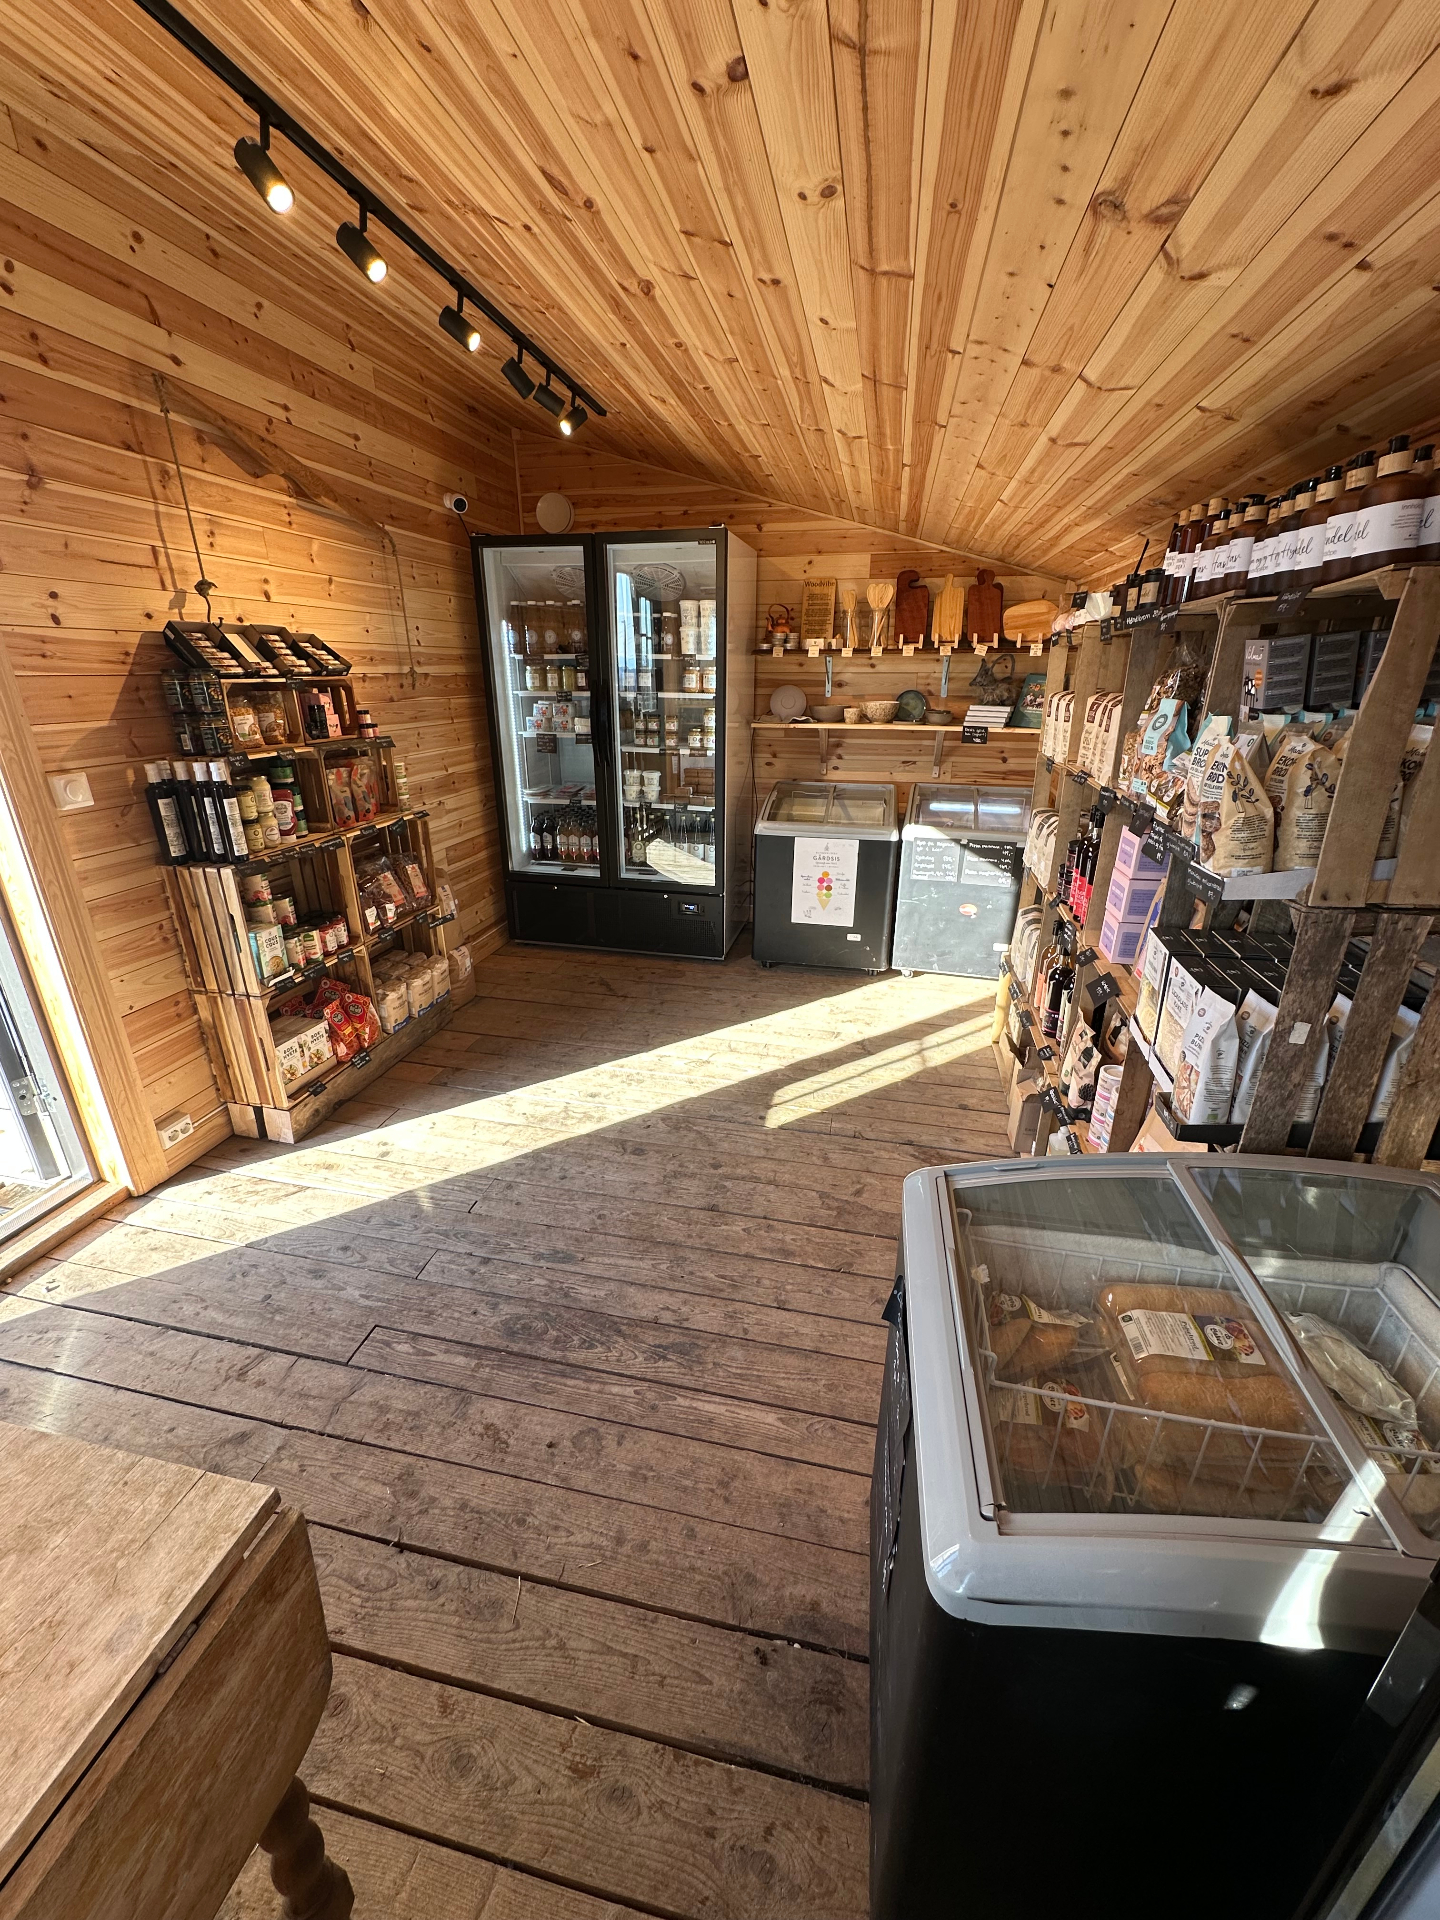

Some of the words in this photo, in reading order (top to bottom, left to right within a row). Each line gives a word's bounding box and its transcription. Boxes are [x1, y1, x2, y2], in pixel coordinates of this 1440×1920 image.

[1194, 746, 1209, 757] SUP
[264, 935, 278, 944] COUS
[265, 940, 279, 949] COUS
[310, 1030, 321, 1039] BOK-
[310, 1034, 325, 1044] HVETE
[1194, 1032, 1205, 1042] PIZ
[283, 1045, 296, 1054] BOK-
[283, 1048, 298, 1059] HVETE
